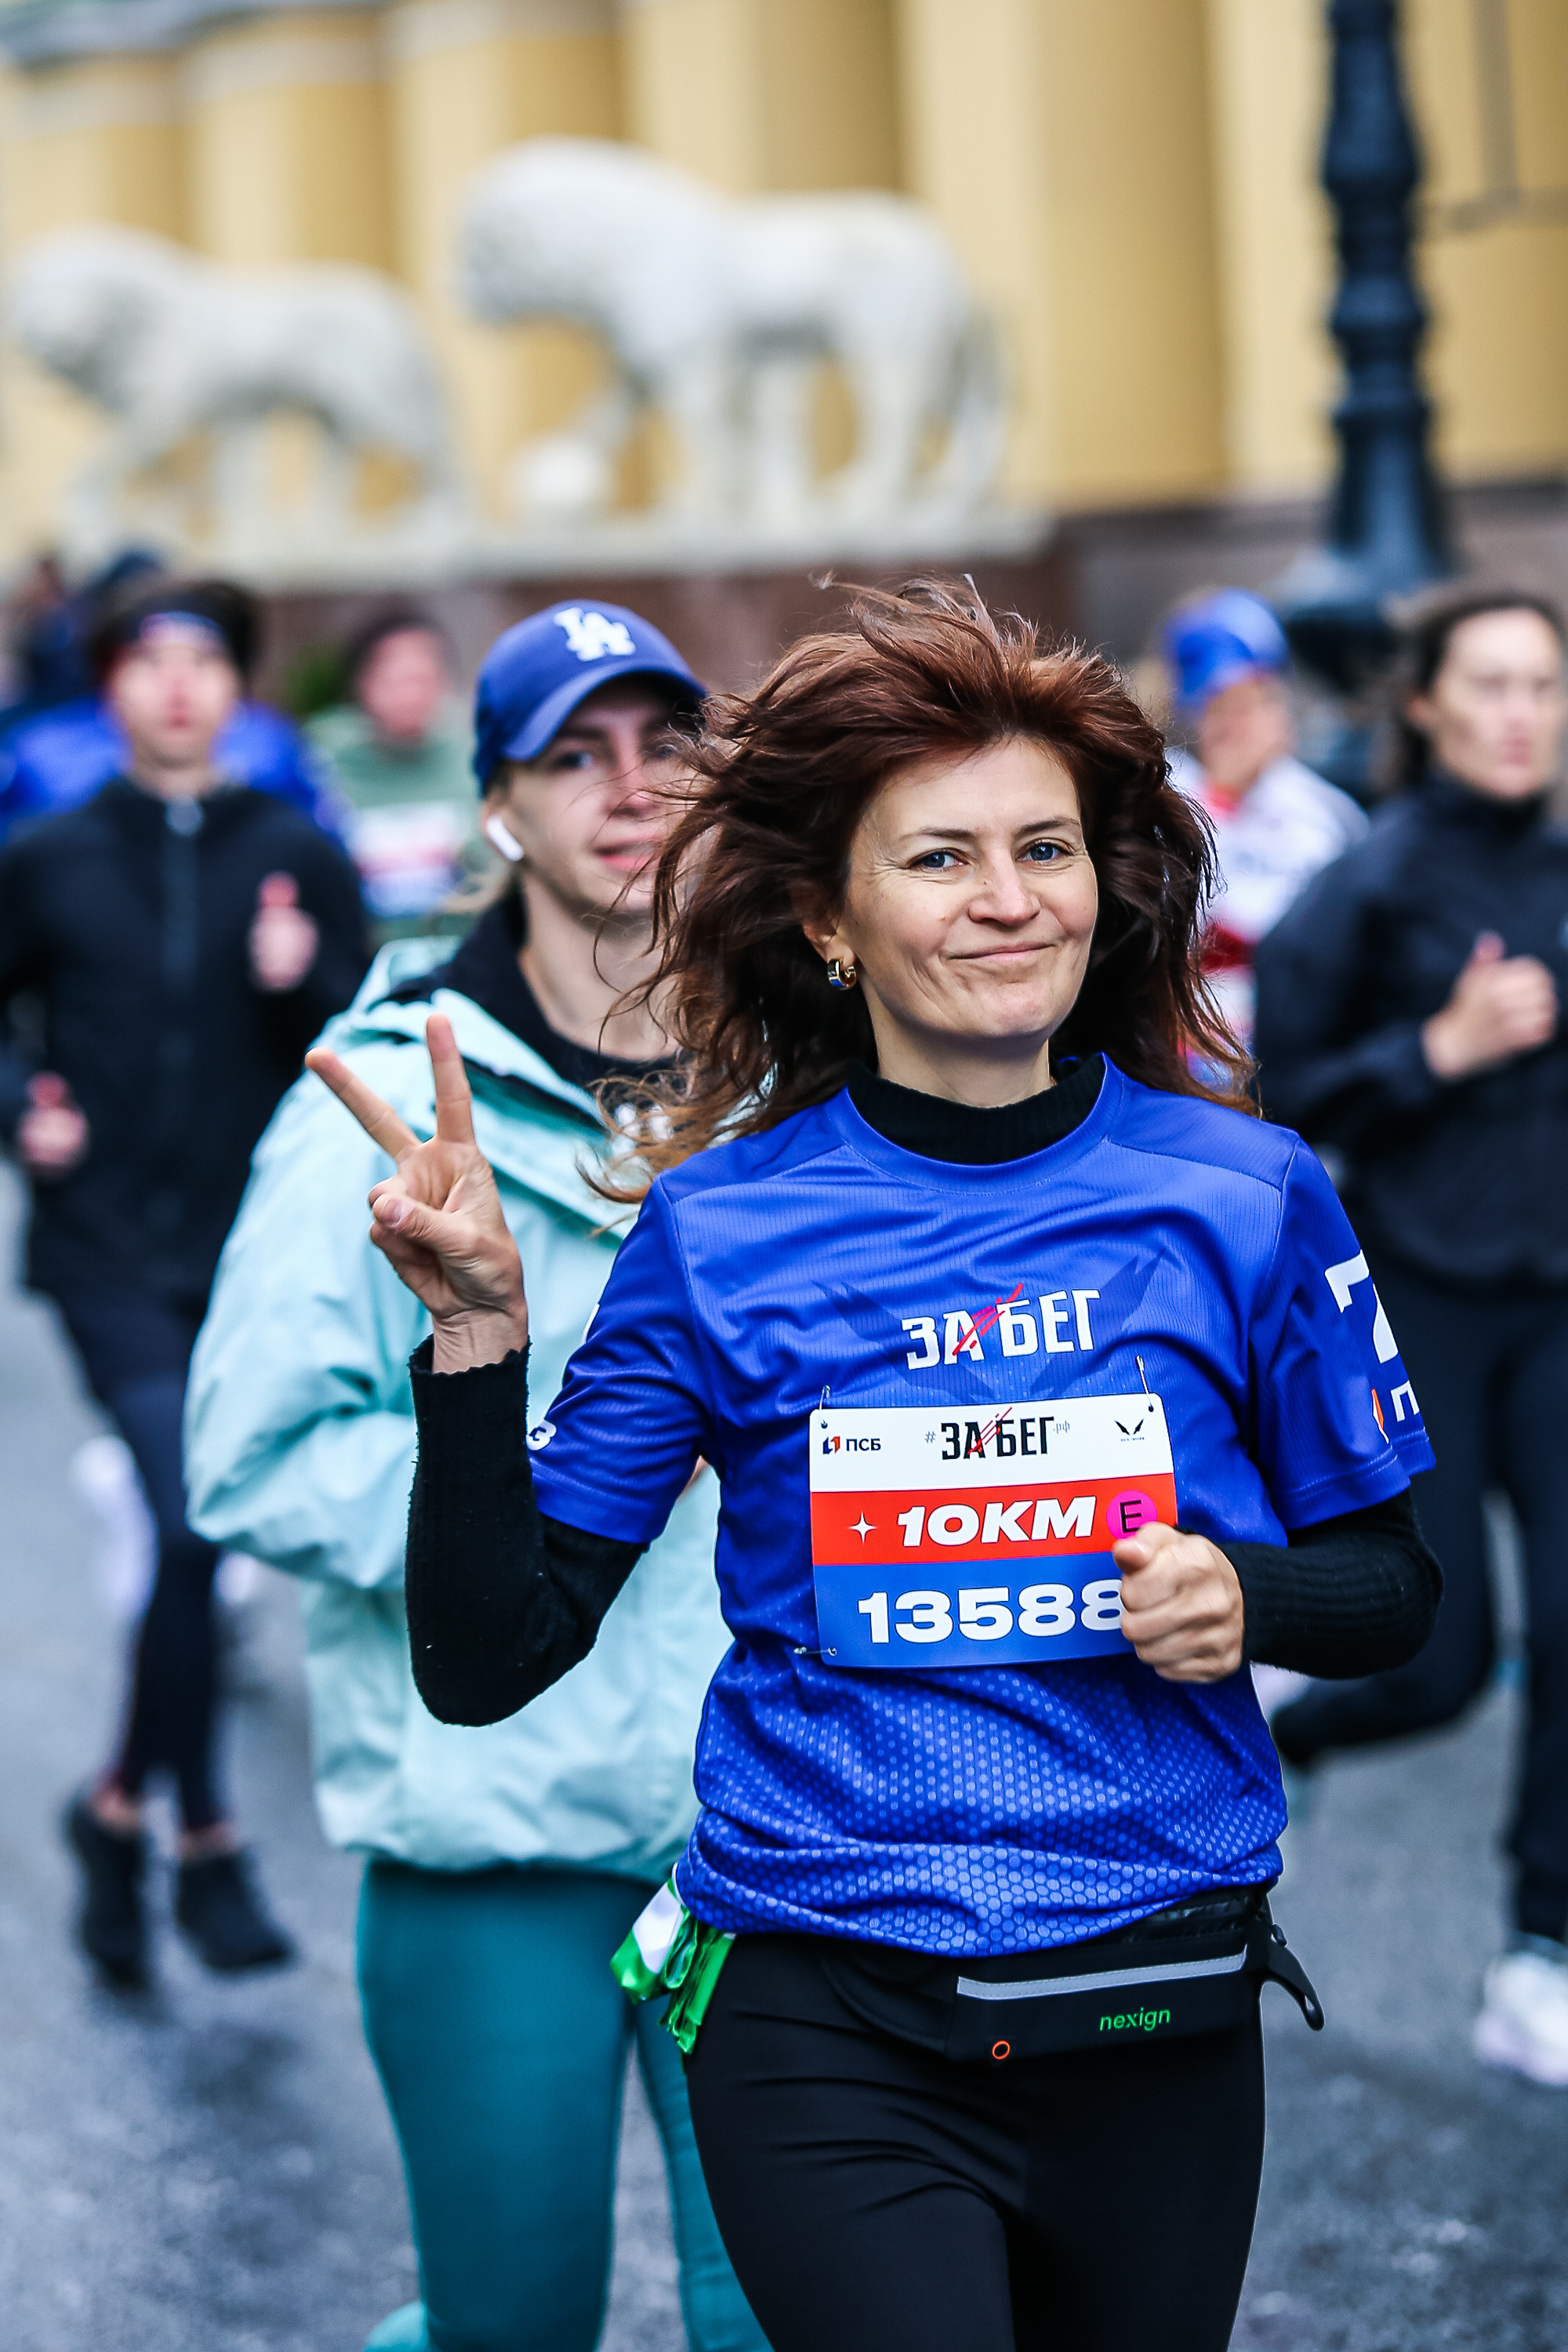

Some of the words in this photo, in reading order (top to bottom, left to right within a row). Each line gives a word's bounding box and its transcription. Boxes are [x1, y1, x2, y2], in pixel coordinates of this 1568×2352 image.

[845, 1437, 882, 1452] ПСБ
[857, 1579, 1123, 1644] 13588
[1099, 2006, 1171, 2032] nexign
